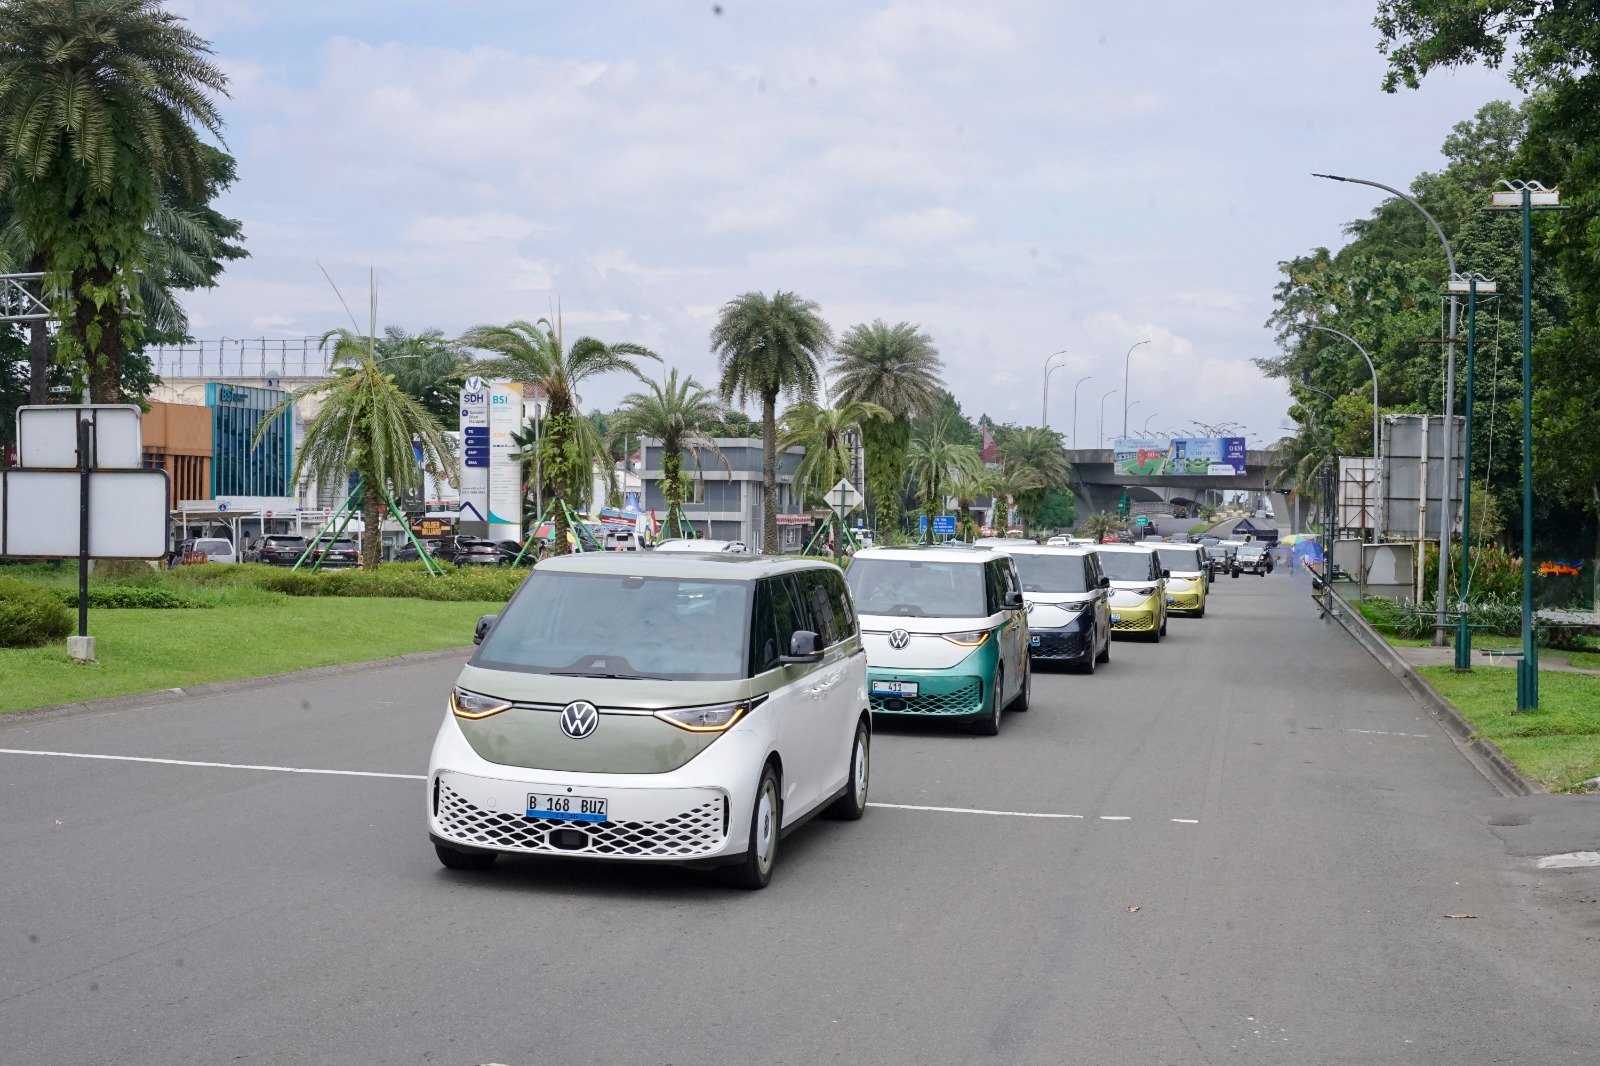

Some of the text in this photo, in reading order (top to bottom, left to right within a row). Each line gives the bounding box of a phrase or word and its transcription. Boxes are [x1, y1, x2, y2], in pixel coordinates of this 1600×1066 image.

[464, 394, 484, 403] SDH
[492, 395, 508, 404] BSI
[888, 682, 902, 692] 411
[562, 701, 598, 738] VW
[529, 795, 605, 815] B 168 BUZ
